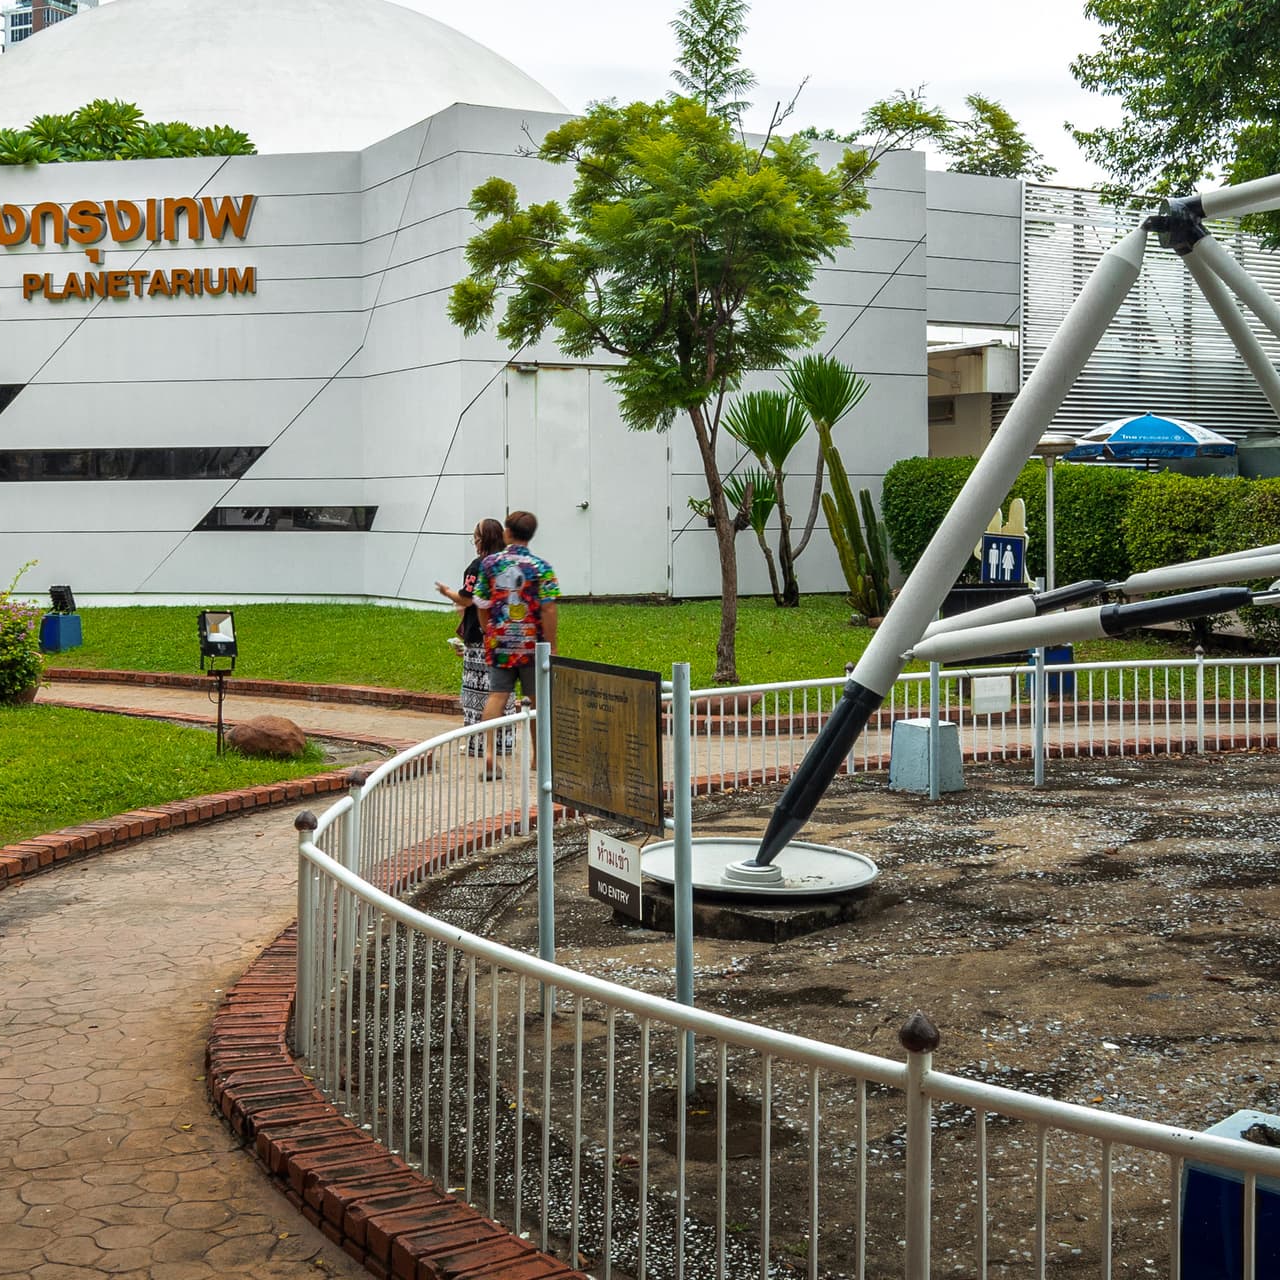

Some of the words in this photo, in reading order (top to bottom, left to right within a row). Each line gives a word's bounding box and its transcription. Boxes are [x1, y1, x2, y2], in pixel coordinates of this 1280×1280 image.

[22, 265, 258, 301] PLANETARIUM
[597, 839, 630, 873] ห้ามเข้า
[597, 880, 608, 895] NO
[608, 885, 630, 905] ENTRY
